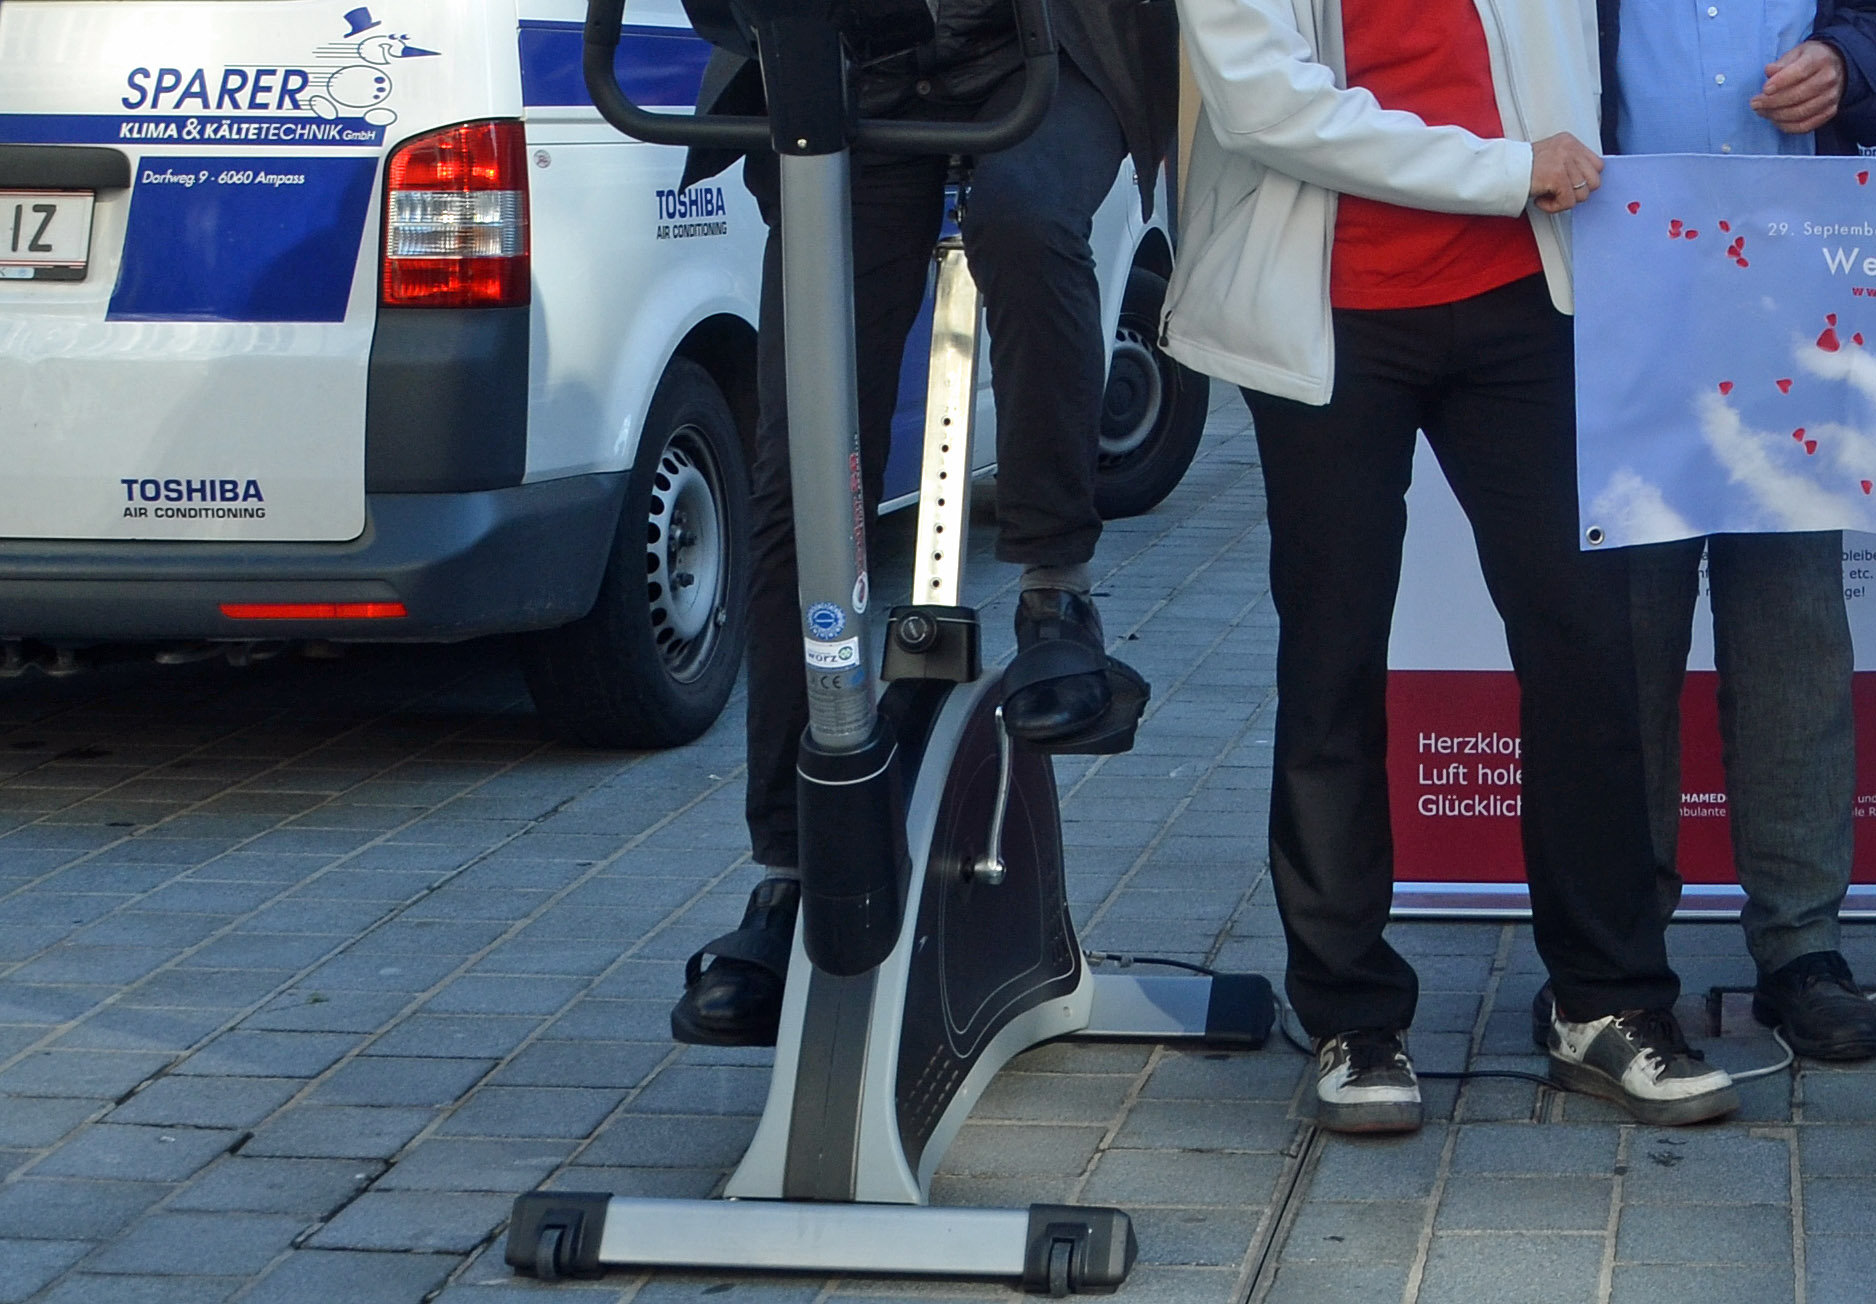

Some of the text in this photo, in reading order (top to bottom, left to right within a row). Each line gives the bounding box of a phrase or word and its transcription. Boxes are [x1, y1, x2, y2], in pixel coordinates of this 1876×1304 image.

[121, 67, 309, 110] SPARER
[119, 118, 375, 141] KLIMA & KÄLTETECHNIK GmbH
[198, 171, 208, 184] 9
[218, 171, 253, 185] 6060
[255, 172, 305, 187] Ampass
[656, 187, 726, 220] TOSHIBA
[657, 221, 727, 240] AIR CONDITIONING
[1767, 222, 1795, 237] 29.
[121, 478, 265, 502] TOSHIBA
[123, 507, 266, 519] AIR CONDITIONING
[1850, 568, 1873, 580] etc.
[1418, 763, 1468, 785] Luft
